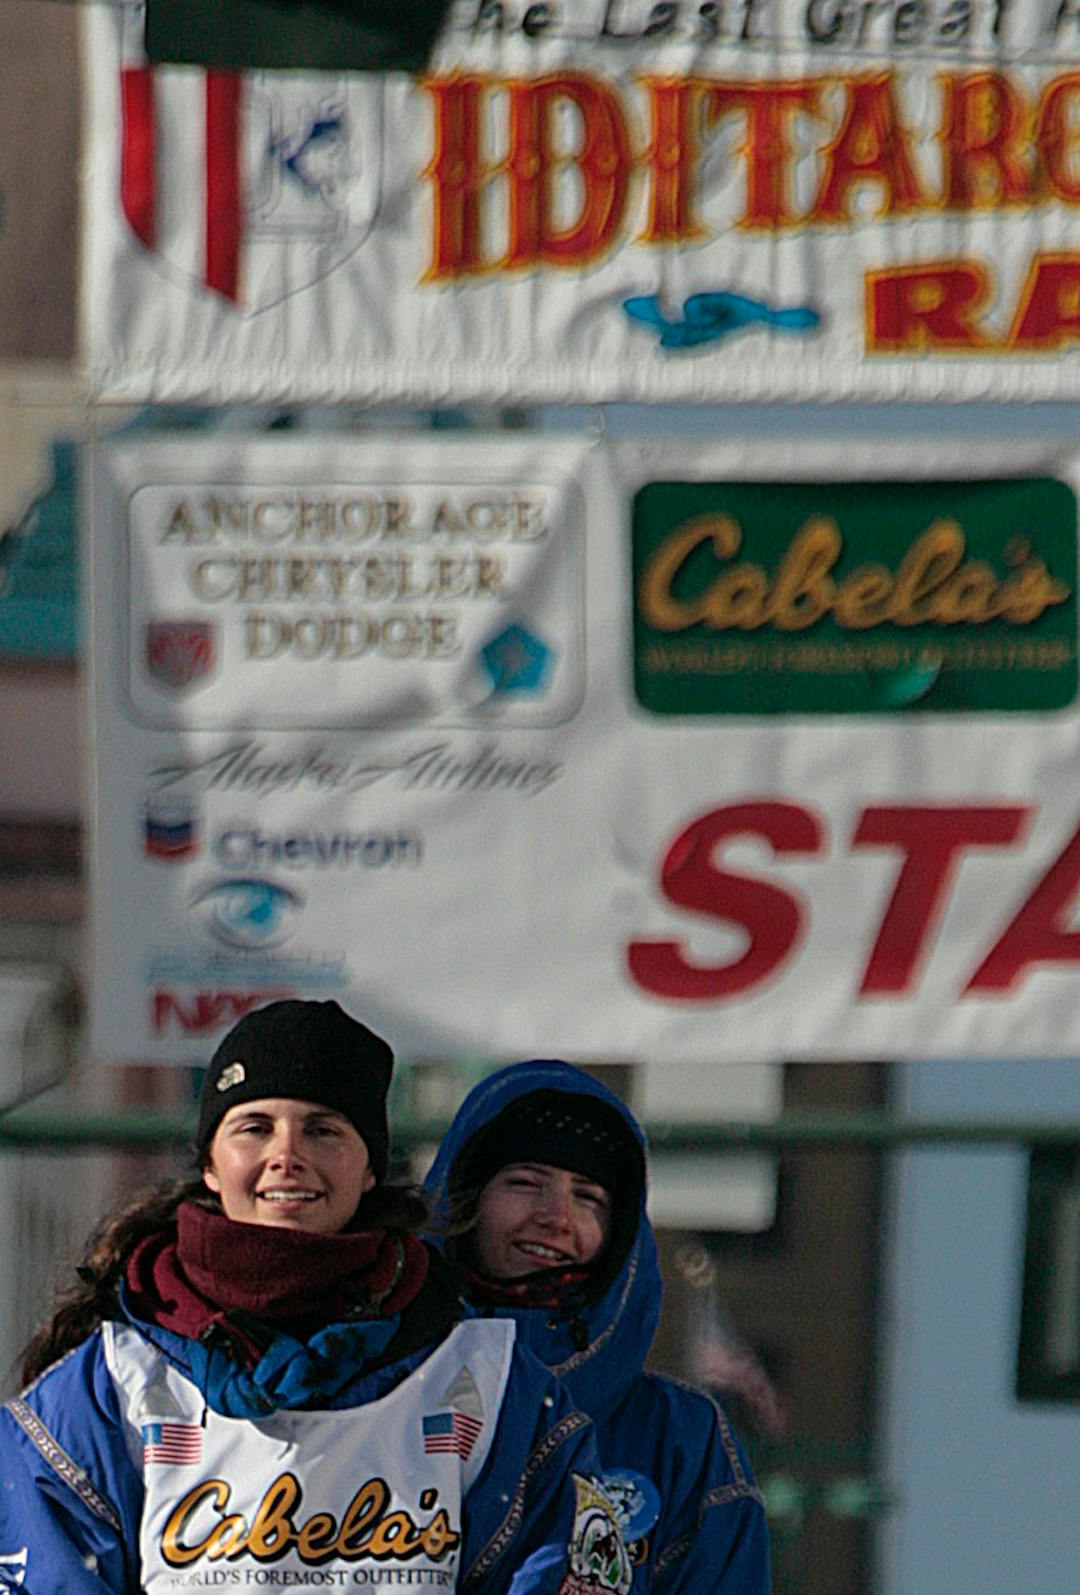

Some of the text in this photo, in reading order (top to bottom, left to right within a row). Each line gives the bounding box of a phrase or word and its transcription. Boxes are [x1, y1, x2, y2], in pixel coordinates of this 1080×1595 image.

[804, 0, 1004, 46] Great
[190, 552, 508, 602] CHRYSLER
[638, 512, 1072, 632] Cabela's
[243, 612, 462, 660] DODGE
[220, 830, 424, 870] Chevron
[161, 1471, 461, 1568] Cabela's
[246, 1568, 348, 1586] FOREMOST
